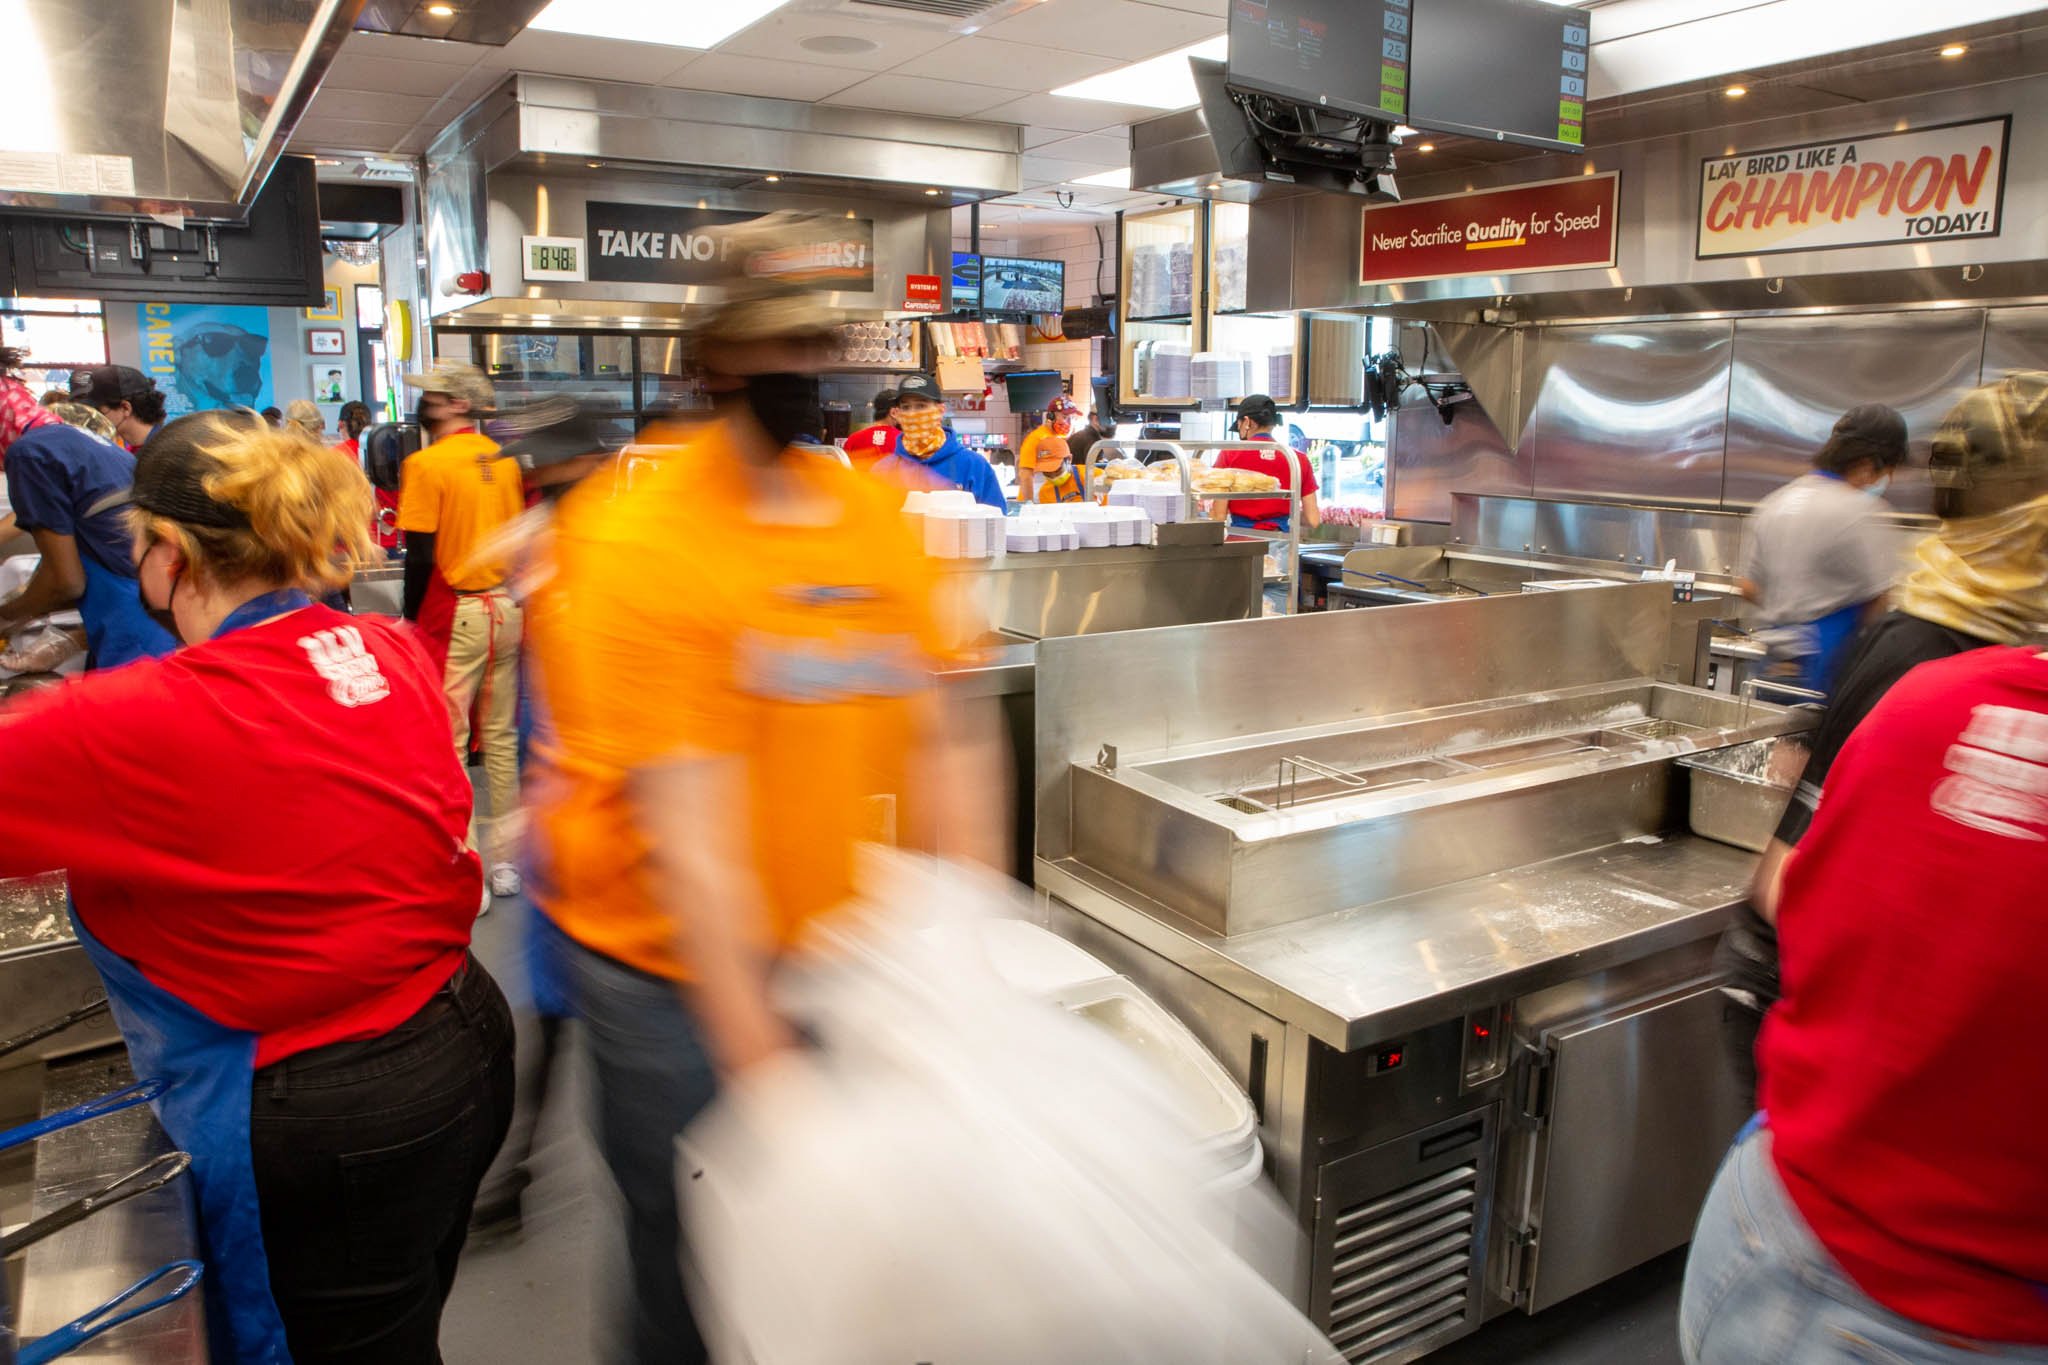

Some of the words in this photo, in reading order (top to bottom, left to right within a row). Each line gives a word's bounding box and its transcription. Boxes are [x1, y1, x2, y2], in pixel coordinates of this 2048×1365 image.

[1388, 15, 1403, 32] 22
[1572, 30, 1580, 42] 0
[1387, 43, 1402, 58] 25
[1570, 55, 1578, 68] 0
[1569, 80, 1577, 93] 0
[1708, 159, 1740, 181] LAY
[1746, 154, 1790, 176] BIRD
[1796, 148, 1835, 170] LIKE
[1840, 145, 1857, 163] A
[1706, 145, 1994, 233] CHAMPION
[1373, 233, 1408, 251] Never
[1410, 223, 1462, 247] Sacrifice
[1466, 217, 1527, 242] Quality
[1530, 212, 1551, 235] for
[1554, 205, 1600, 238] Speed
[1905, 211, 1989, 237] TODAY!
[598, 230, 664, 257] TAKE
[670, 234, 715, 262] NO
